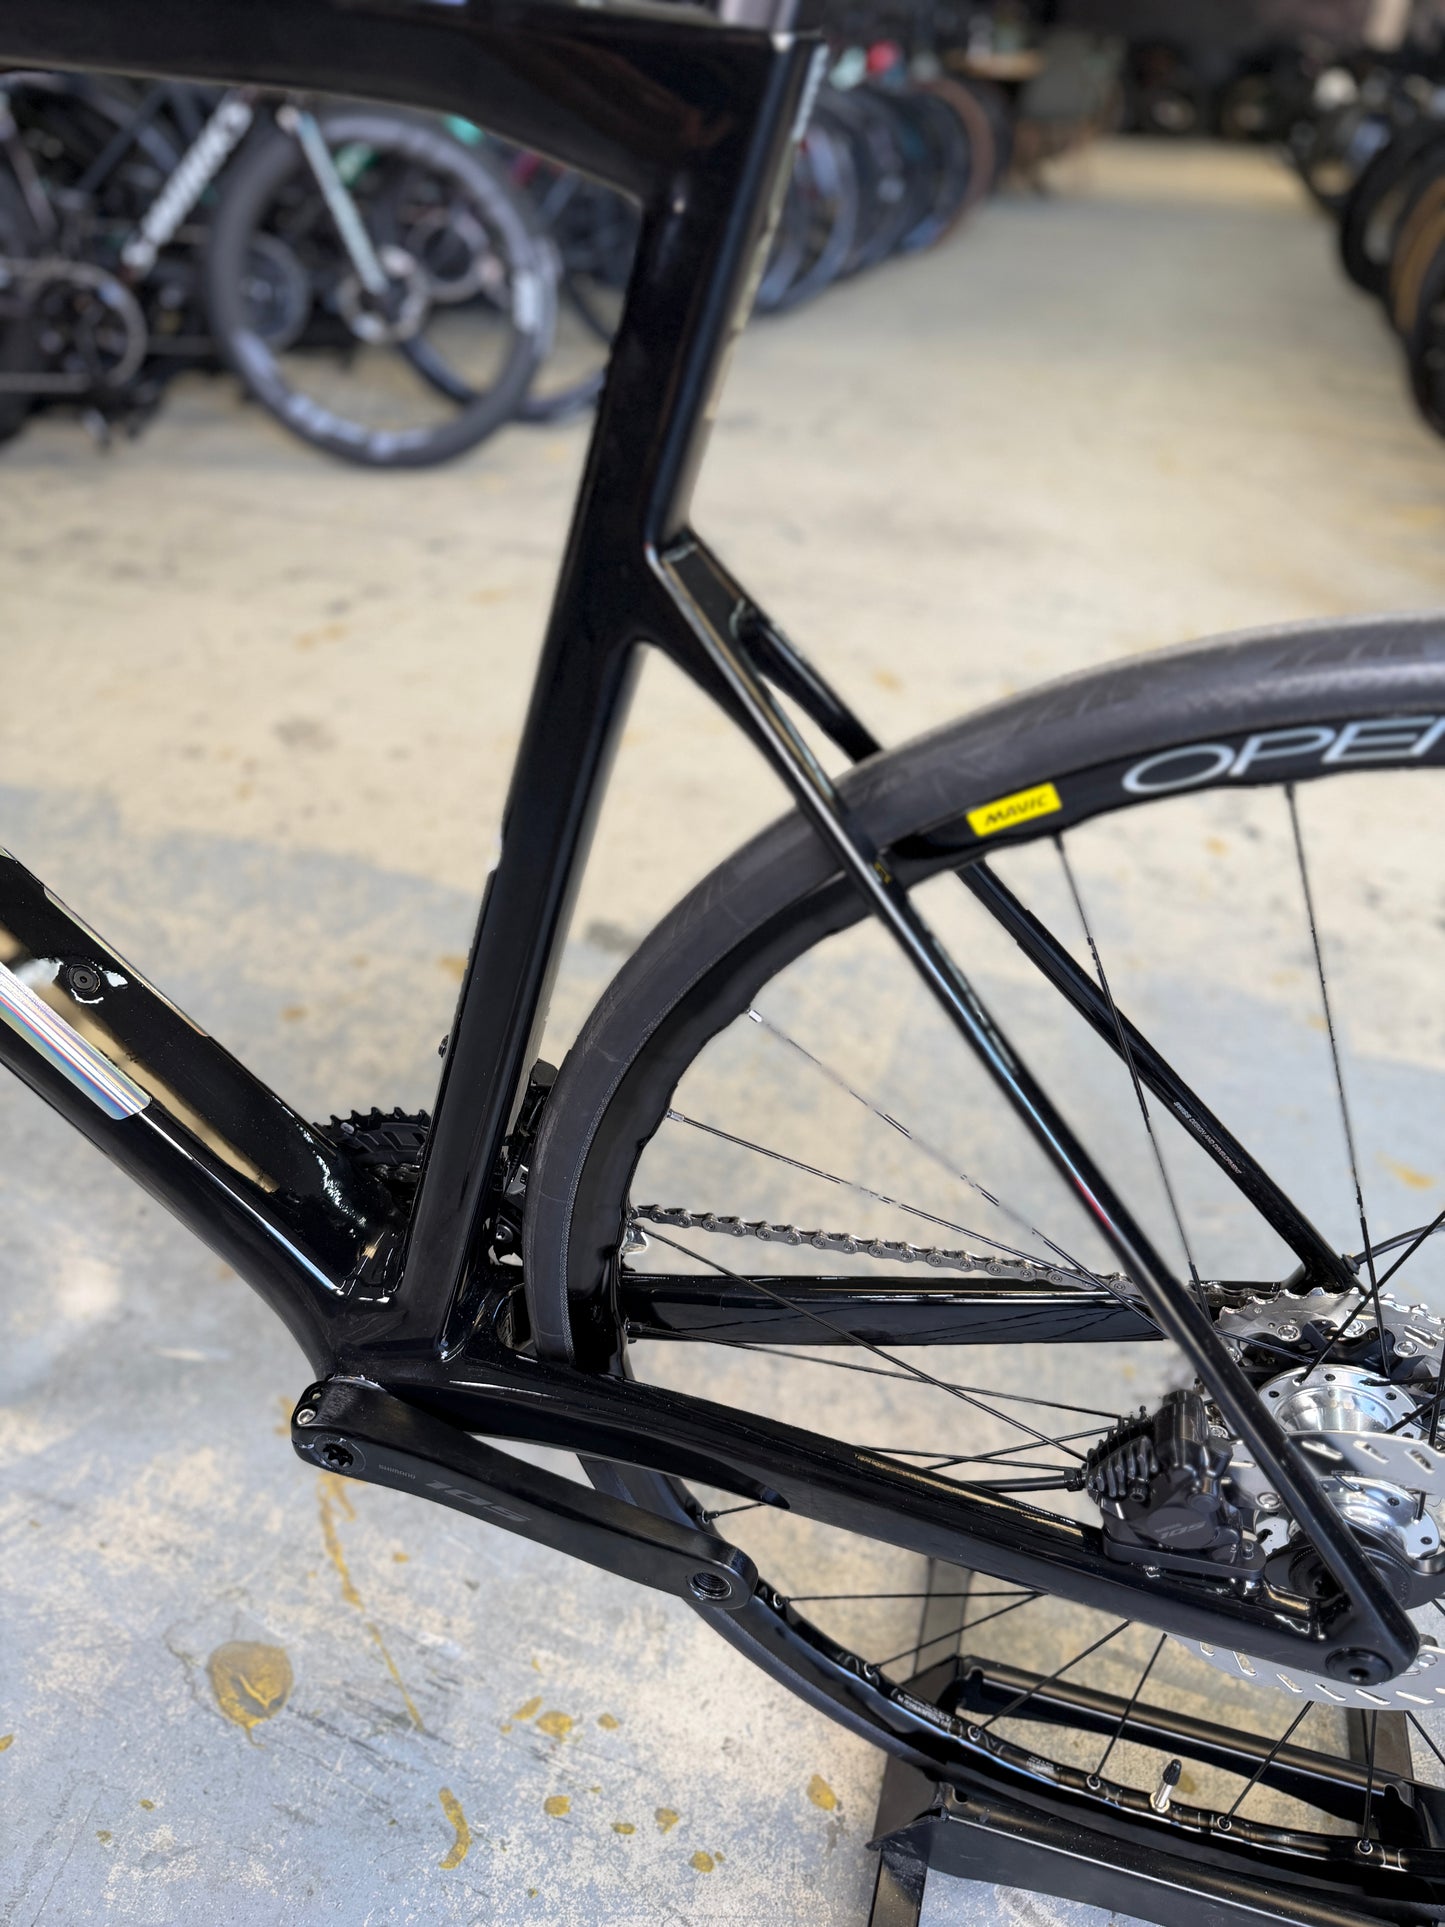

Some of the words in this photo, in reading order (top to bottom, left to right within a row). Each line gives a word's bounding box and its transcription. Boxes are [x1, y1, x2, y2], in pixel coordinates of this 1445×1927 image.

[984, 793, 1048, 827] MAVIC
[1173, 1101, 1192, 1119] SWISS
[1189, 1118, 1207, 1135] DESIGN
[425, 1479, 532, 1523] 105
[1159, 1520, 1207, 1540] 105
